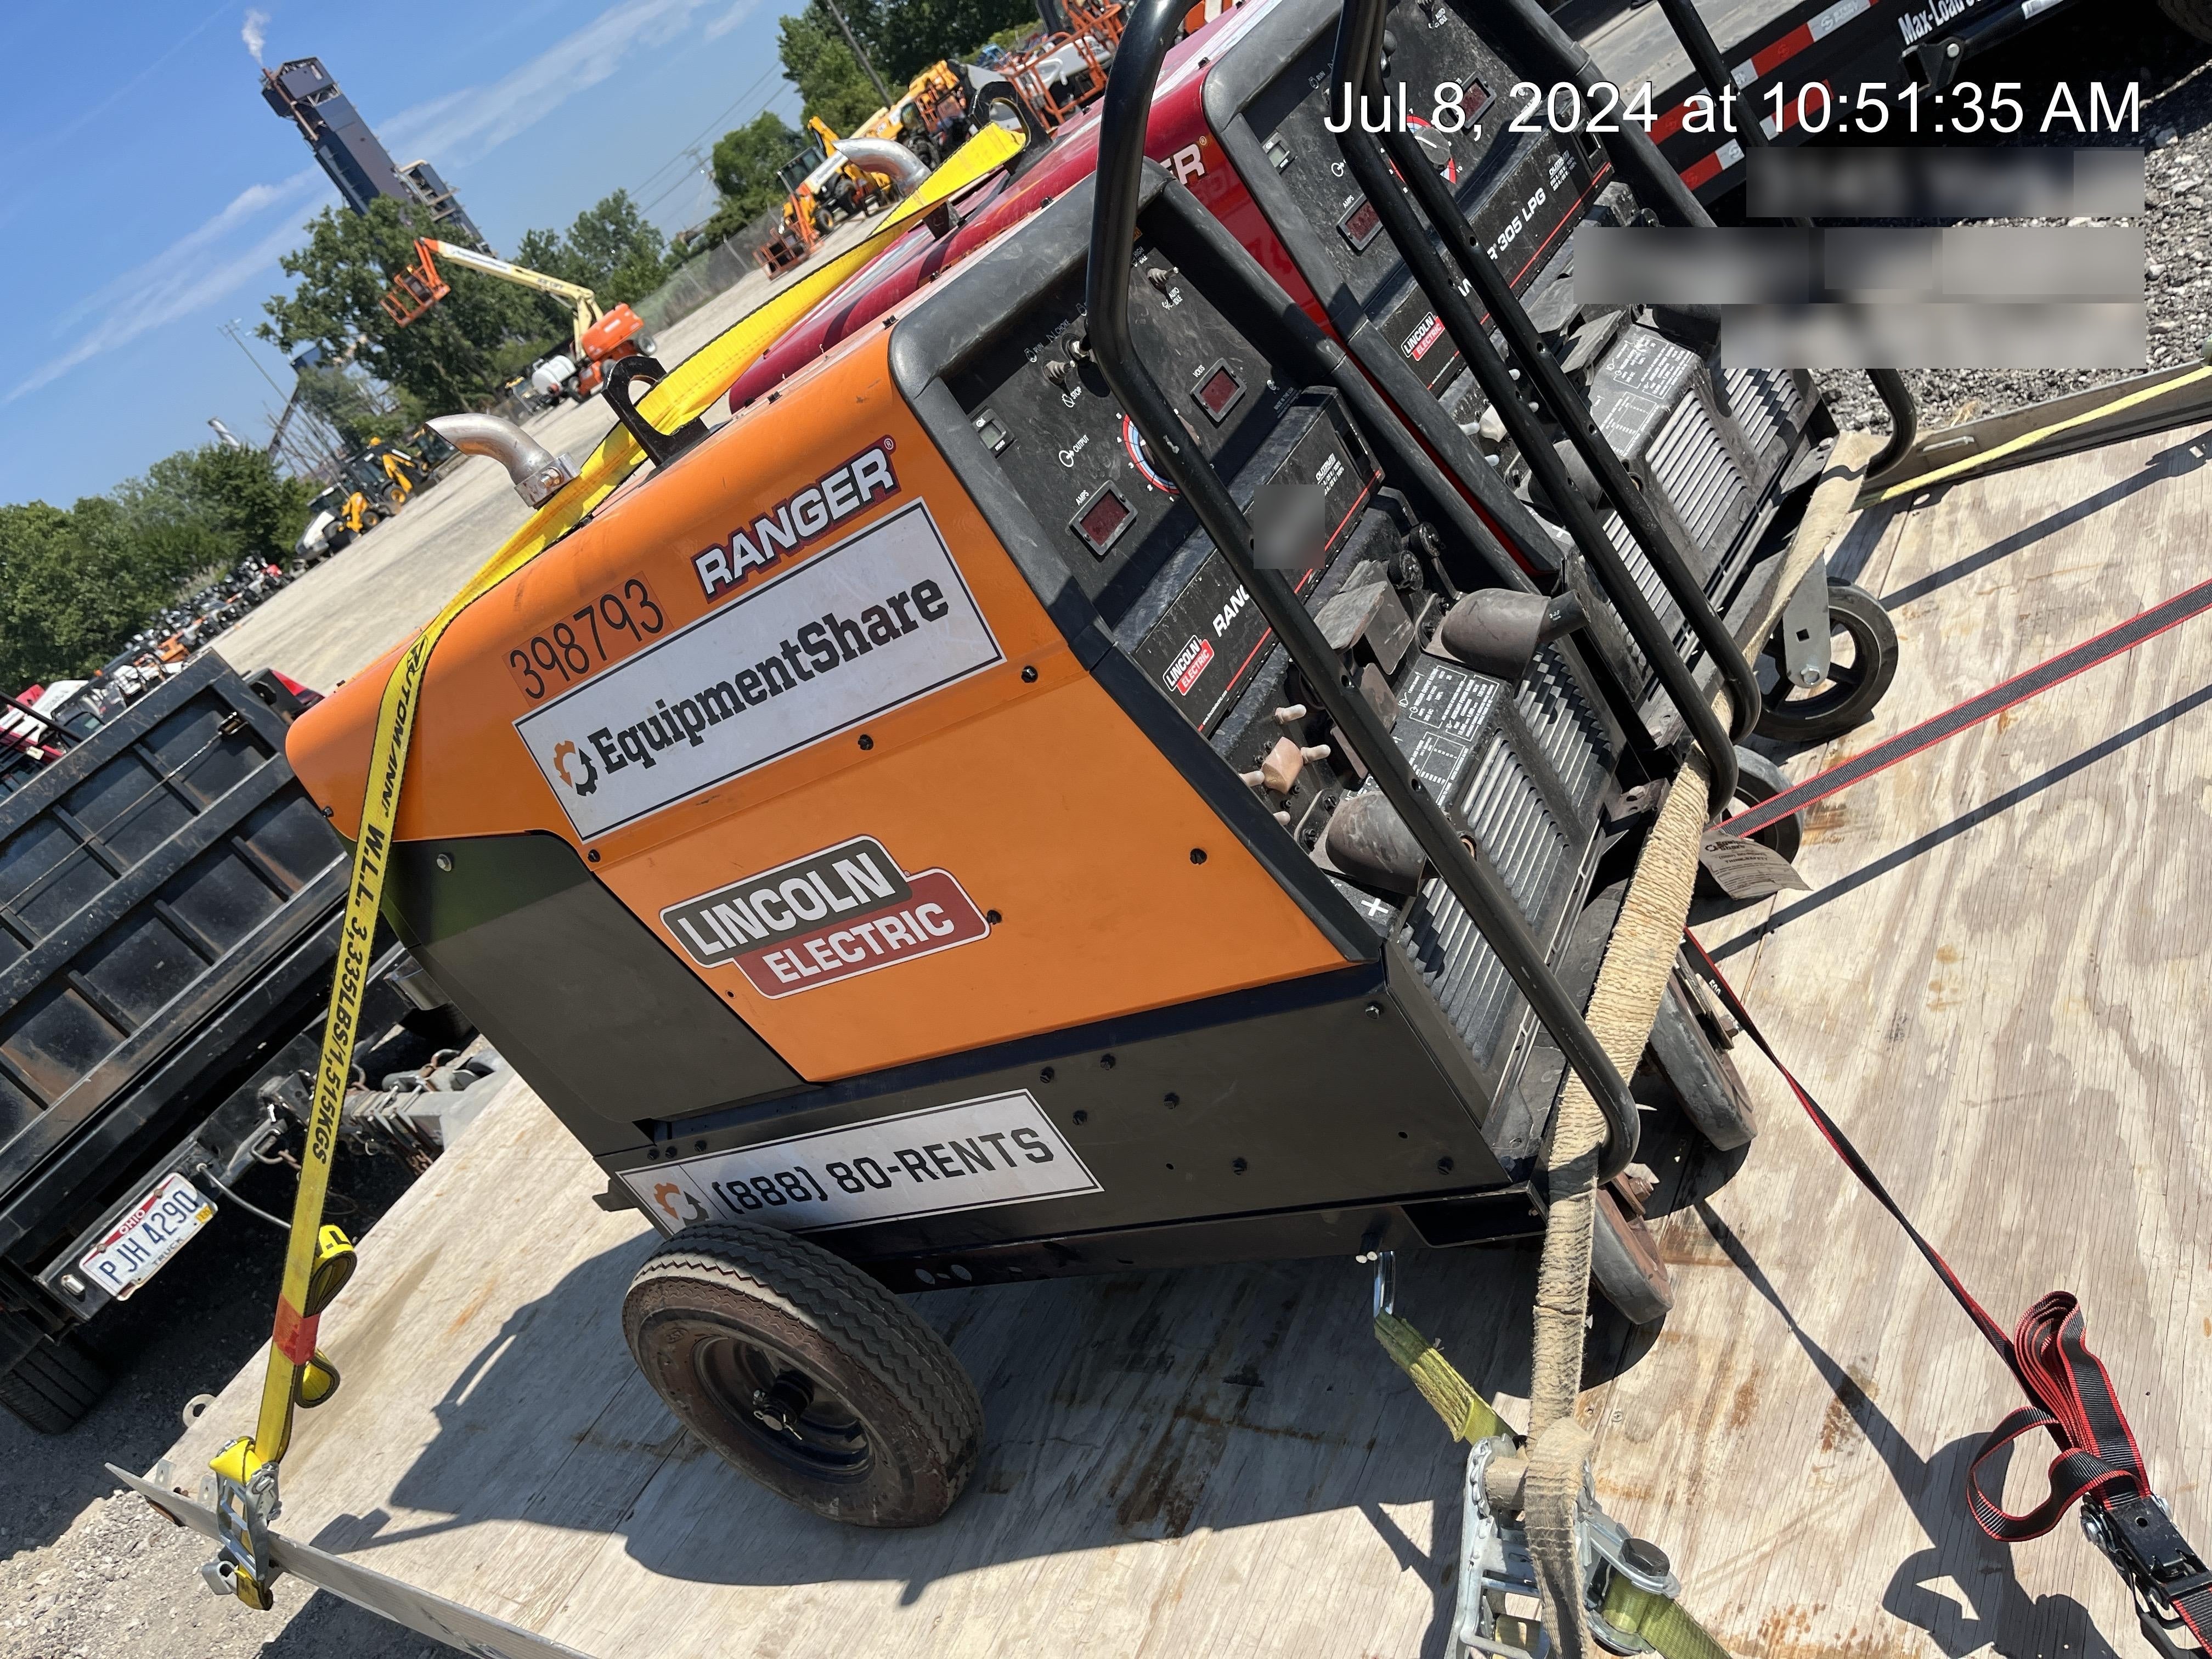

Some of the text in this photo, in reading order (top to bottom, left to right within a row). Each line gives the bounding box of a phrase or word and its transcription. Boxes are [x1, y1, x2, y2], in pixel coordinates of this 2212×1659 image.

[1549, 149, 1570, 176] OUTPUT
[1342, 195, 1355, 209] AMPS
[1497, 187, 1546, 251] 305 LPG
[1169, 287, 1180, 300] AUTO
[1173, 295, 1183, 306] IDLE
[1033, 342, 1044, 354] RUN
[1403, 315, 1435, 354] LINCOLN
[1417, 324, 1442, 356] ELECTRIC
[1192, 364, 1205, 377] VOLTS
[1070, 386, 1082, 400] STOP
[1073, 435, 1090, 453] OUTPUT
[1315, 453, 1336, 481] OUTPUT
[1075, 489, 1090, 506] AMPS
[510, 578, 665, 698] 398793
[587, 579, 949, 774] EquipmentShare
[1166, 639, 1200, 686] LINCOLN
[1181, 649, 1210, 689] ELECTRIC
[678, 852, 896, 956] LINCOLN
[761, 902, 955, 984] ELECTRIC
[312, 823, 385, 1165] W.L.L. 3,335LBS/1,515KGS
[712, 1127, 1054, 1215] (888) 80-RENTS
[119, 1209, 145, 1235] OHIO
[142, 1190, 199, 1244] 4290
[152, 1238, 185, 1265] TRUCK
